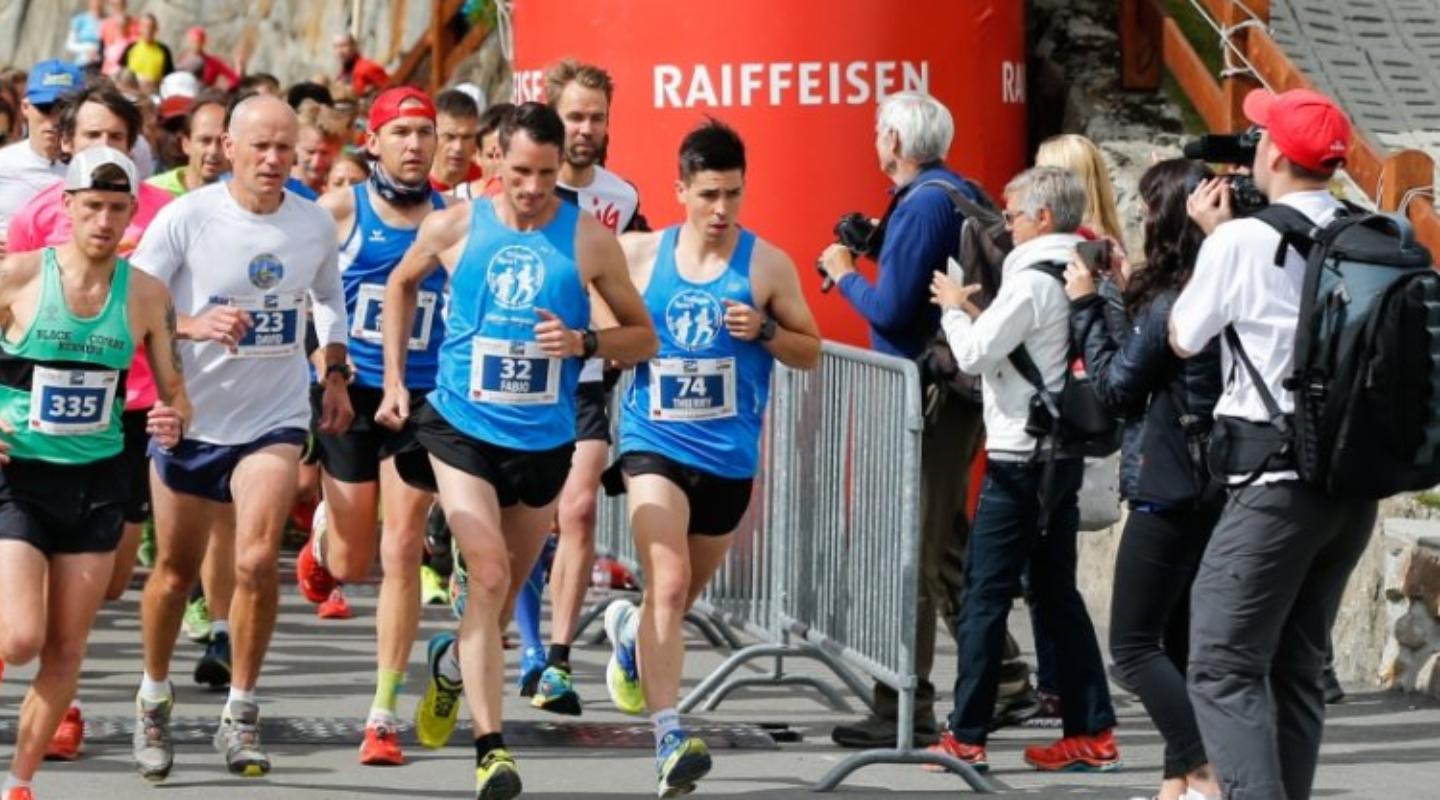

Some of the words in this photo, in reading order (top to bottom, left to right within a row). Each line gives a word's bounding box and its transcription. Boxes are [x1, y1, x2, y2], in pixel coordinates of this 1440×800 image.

[653, 61, 929, 108] RAIFFEISEN
[255, 313, 284, 333] 23
[500, 357, 533, 380] 32
[500, 379, 531, 393] FABIO
[677, 377, 707, 397] 74
[48, 394, 99, 418] 335
